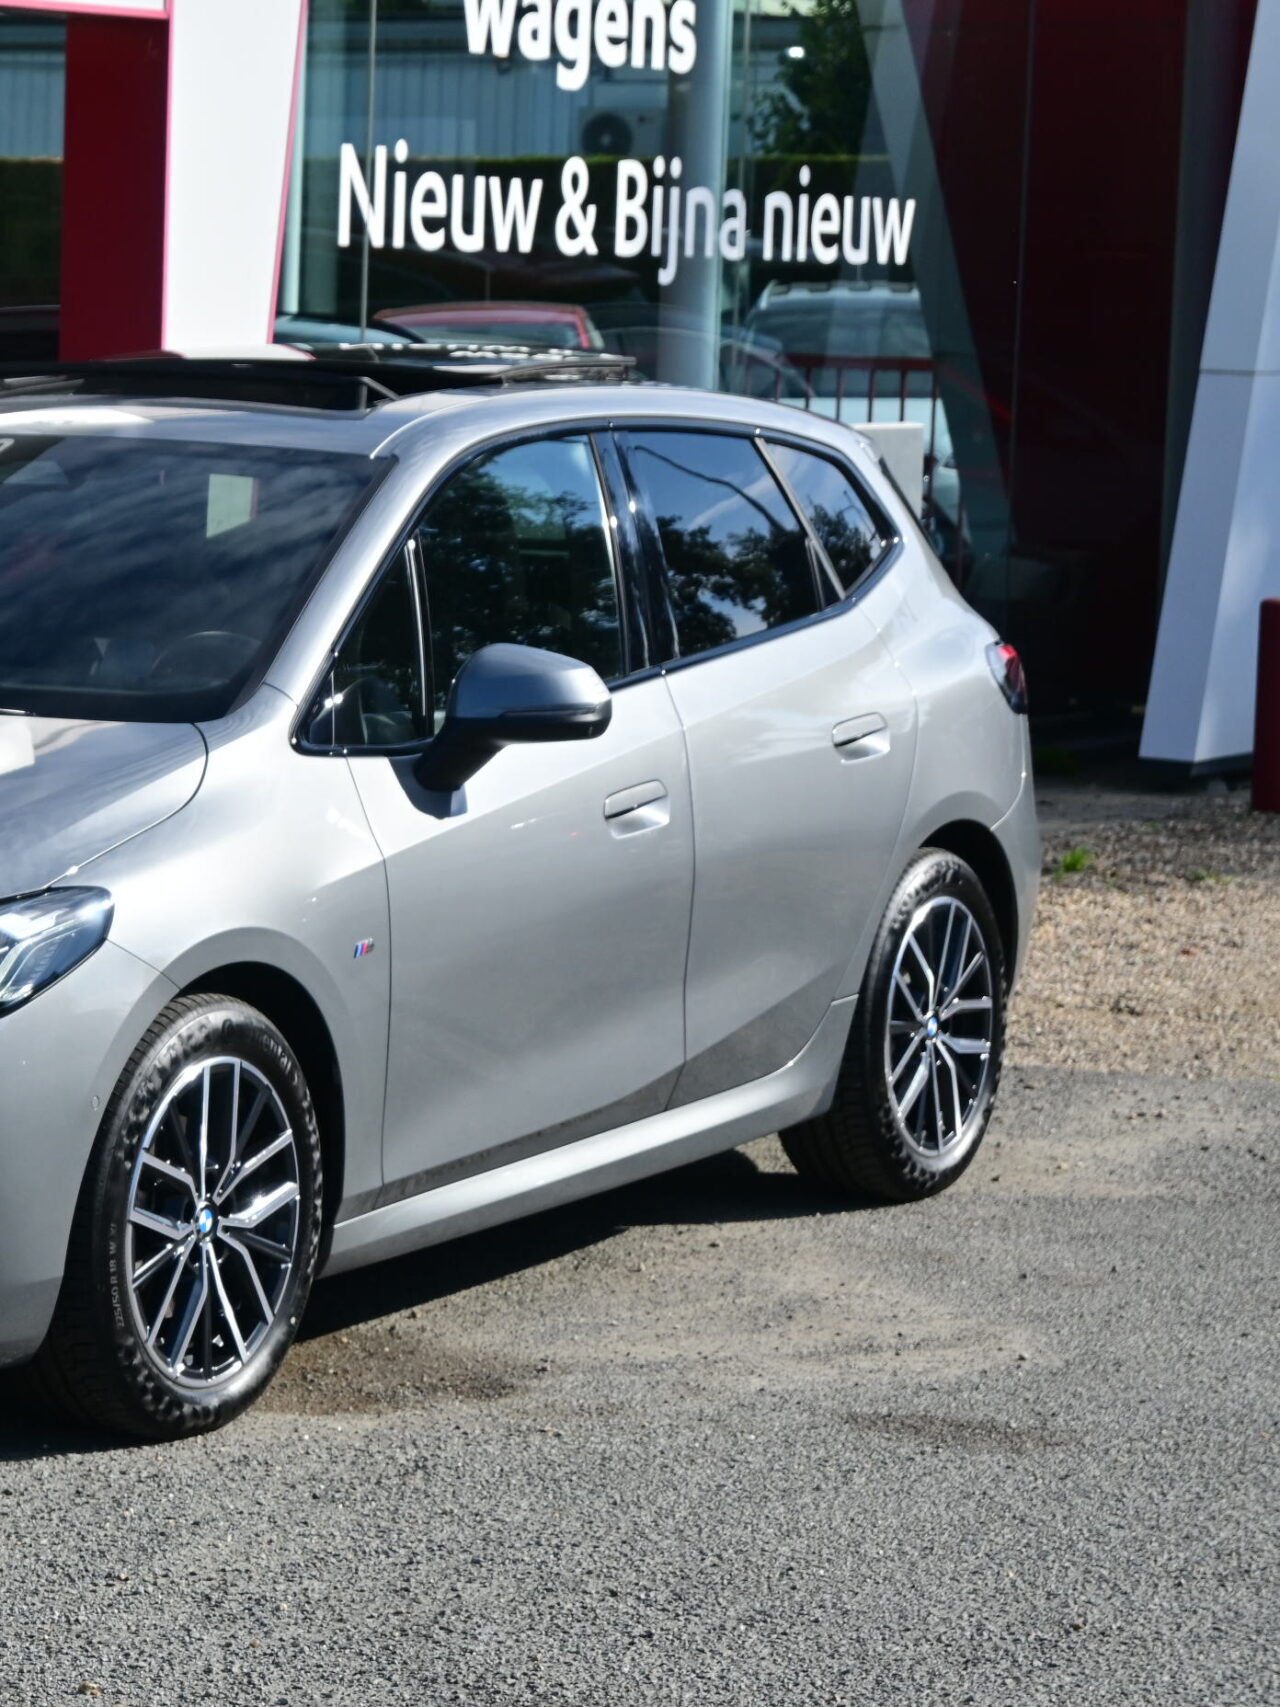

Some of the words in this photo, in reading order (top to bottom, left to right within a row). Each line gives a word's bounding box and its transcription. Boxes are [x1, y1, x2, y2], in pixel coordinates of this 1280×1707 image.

[336, 138, 544, 254] Nieuw
[554, 156, 599, 258] &
[614, 154, 748, 287] Bijna
[762, 164, 918, 266] nieuw
